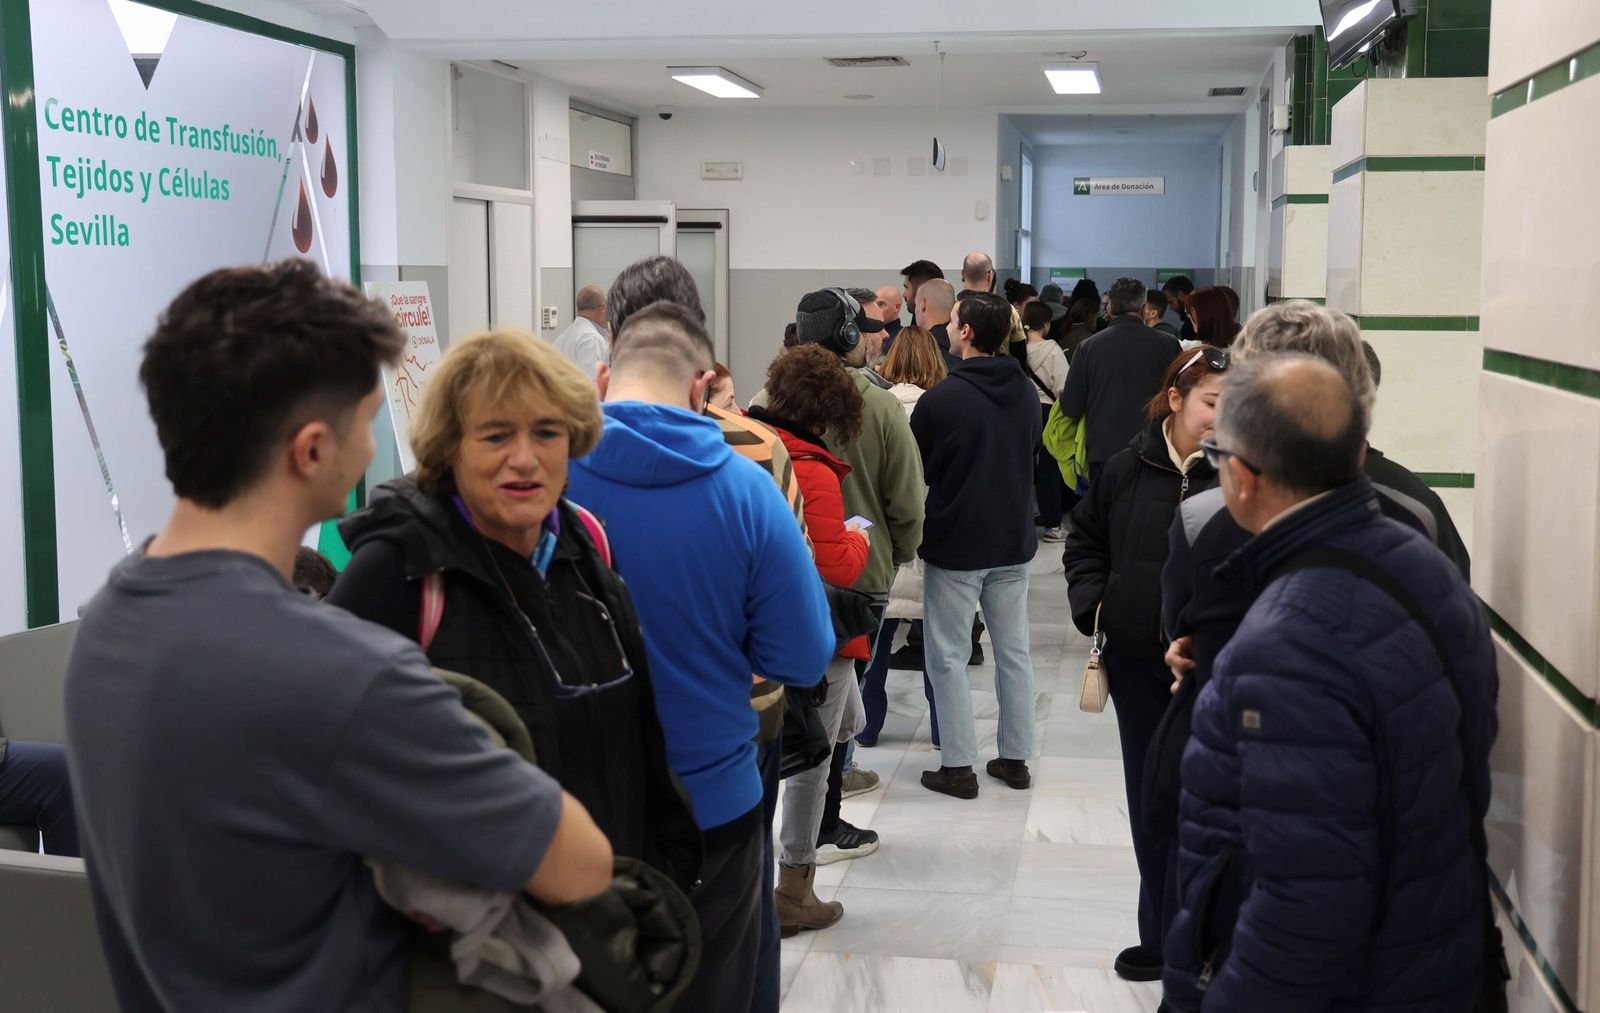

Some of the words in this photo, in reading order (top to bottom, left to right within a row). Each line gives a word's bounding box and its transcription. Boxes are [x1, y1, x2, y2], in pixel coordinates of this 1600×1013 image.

[44, 97, 128, 139] Centro
[134, 110, 161, 144] de
[165, 116, 282, 163] Transfusión,
[46, 155, 134, 199] Tejidos
[139, 171, 152, 203] y
[158, 163, 230, 201] Células
[1121, 182, 1154, 190] Donación
[50, 213, 130, 247] Sevilla
[409, 295, 427, 306] sangre
[395, 306, 432, 328] circule!
